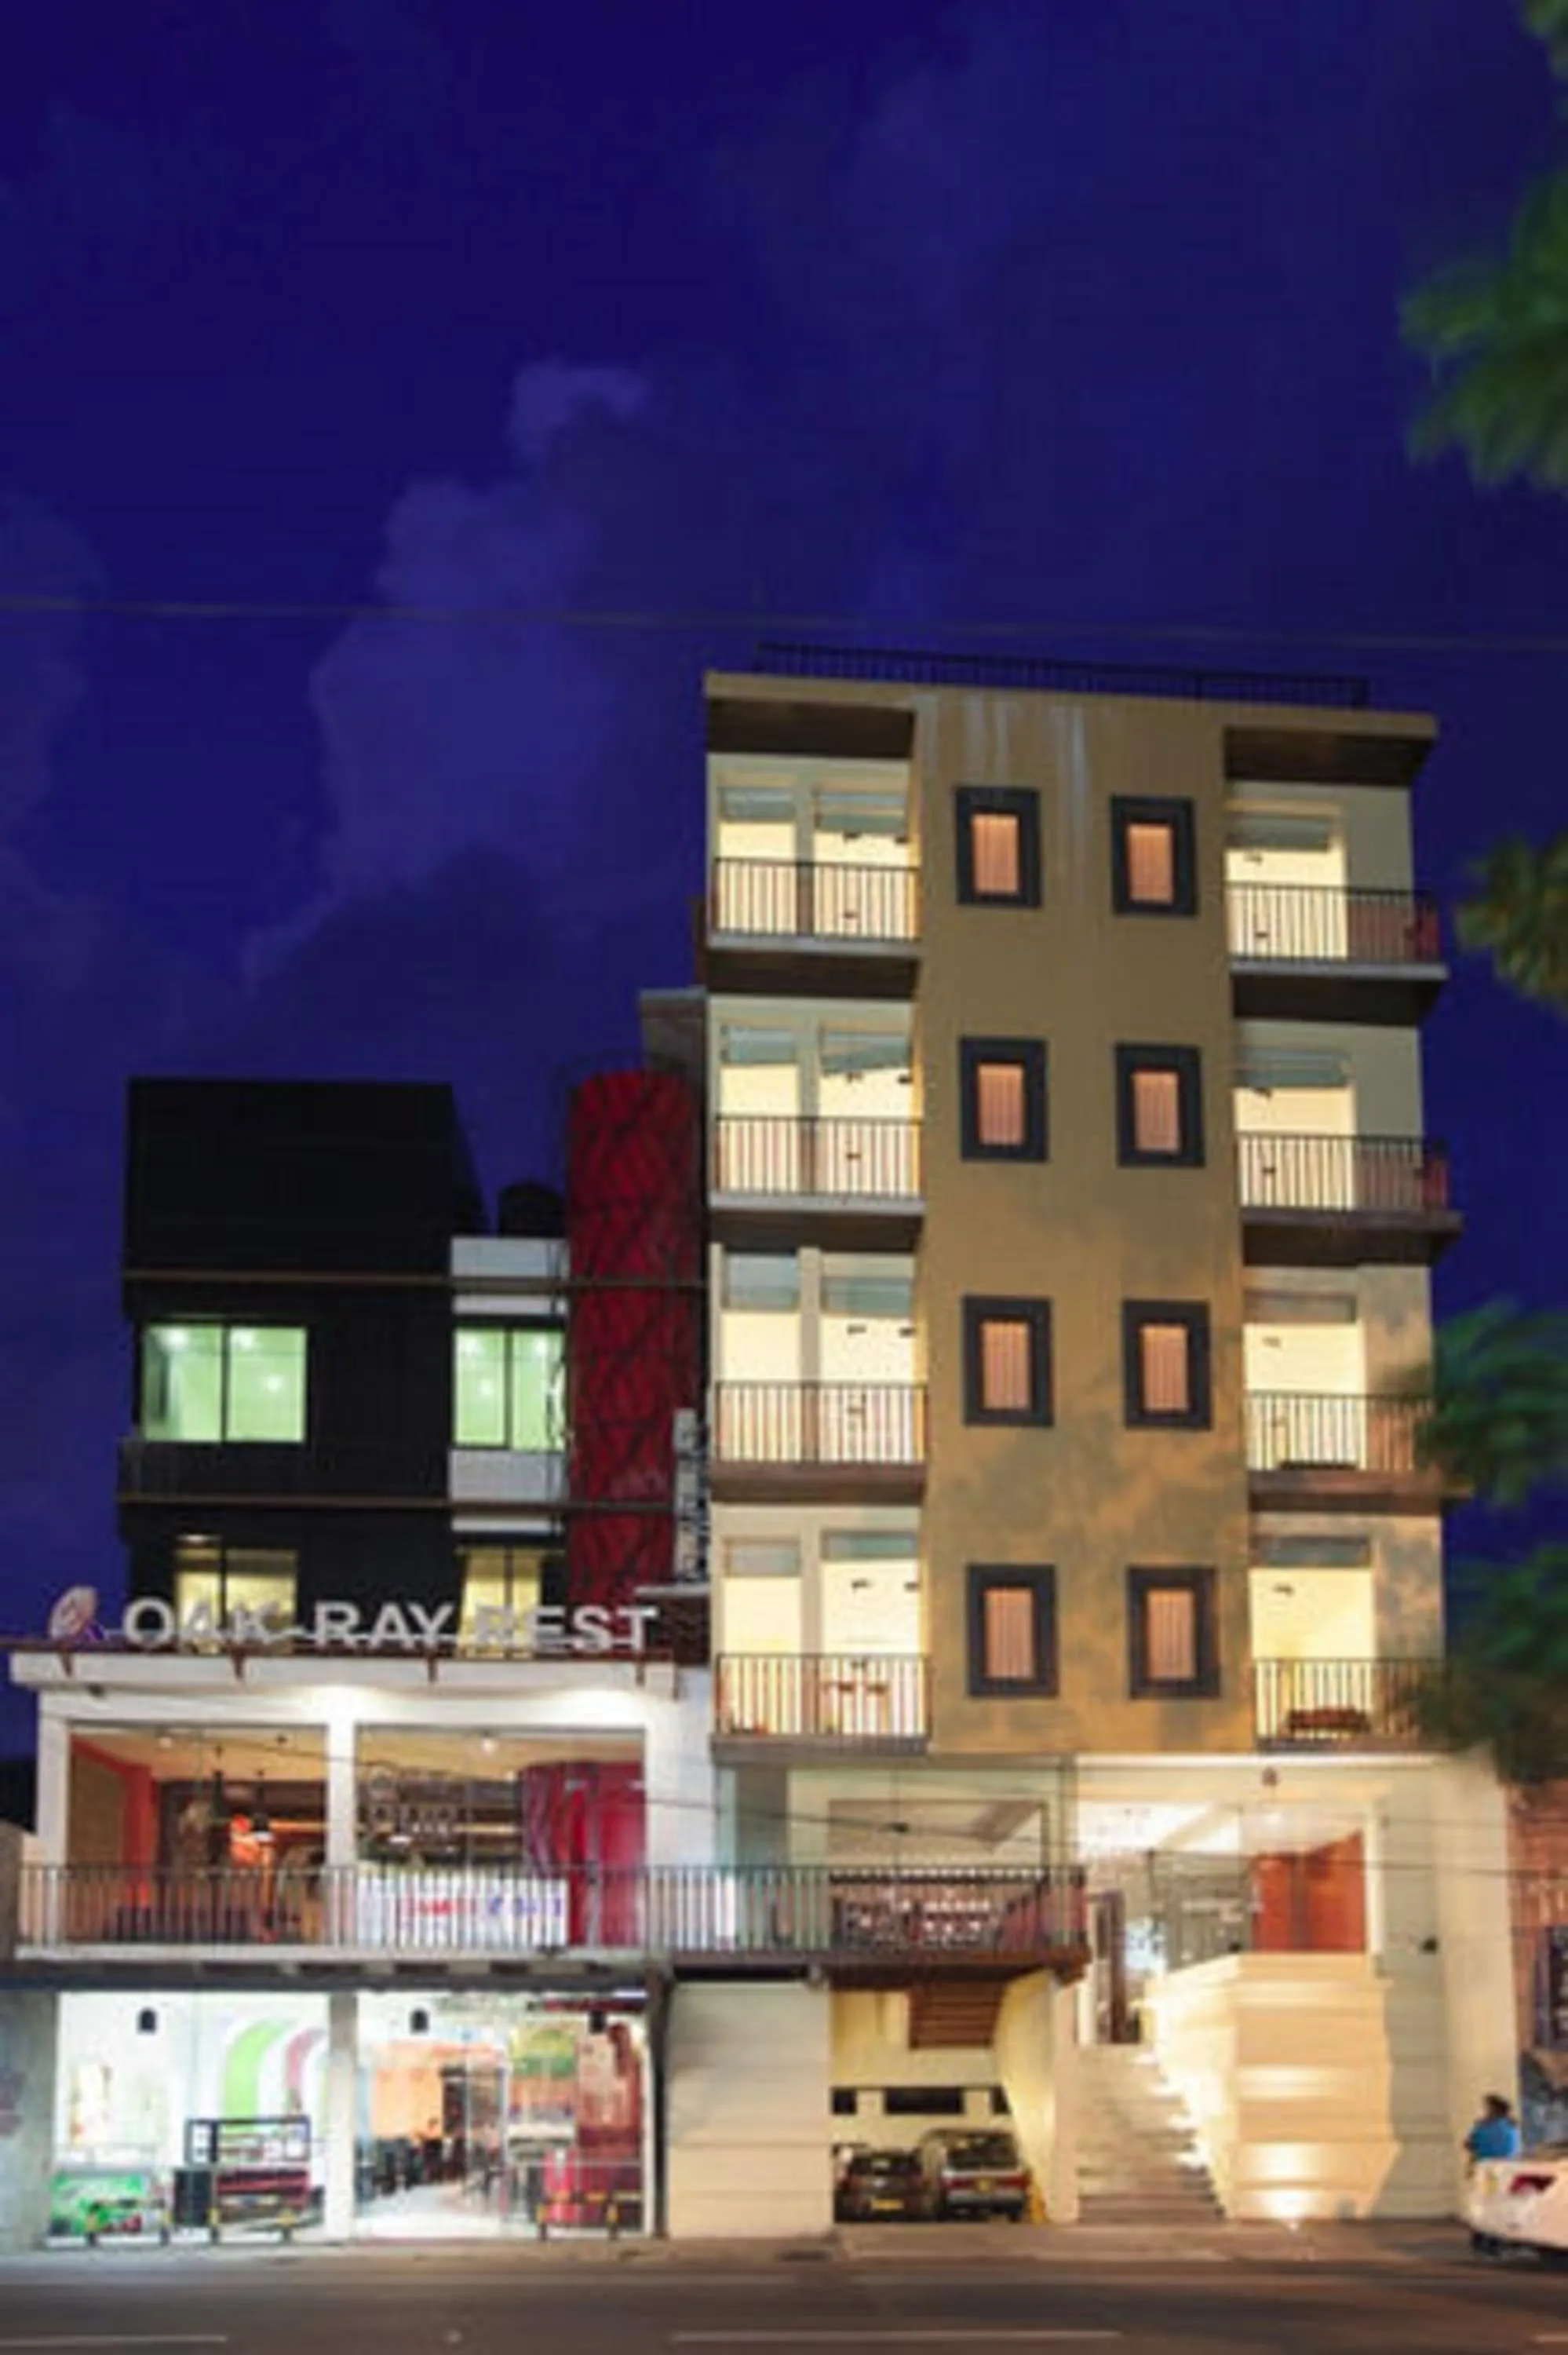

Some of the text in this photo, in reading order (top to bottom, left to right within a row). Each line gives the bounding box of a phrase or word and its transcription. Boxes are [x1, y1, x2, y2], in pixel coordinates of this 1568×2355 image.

[122, 1597, 658, 1654] OAK RAY REST
